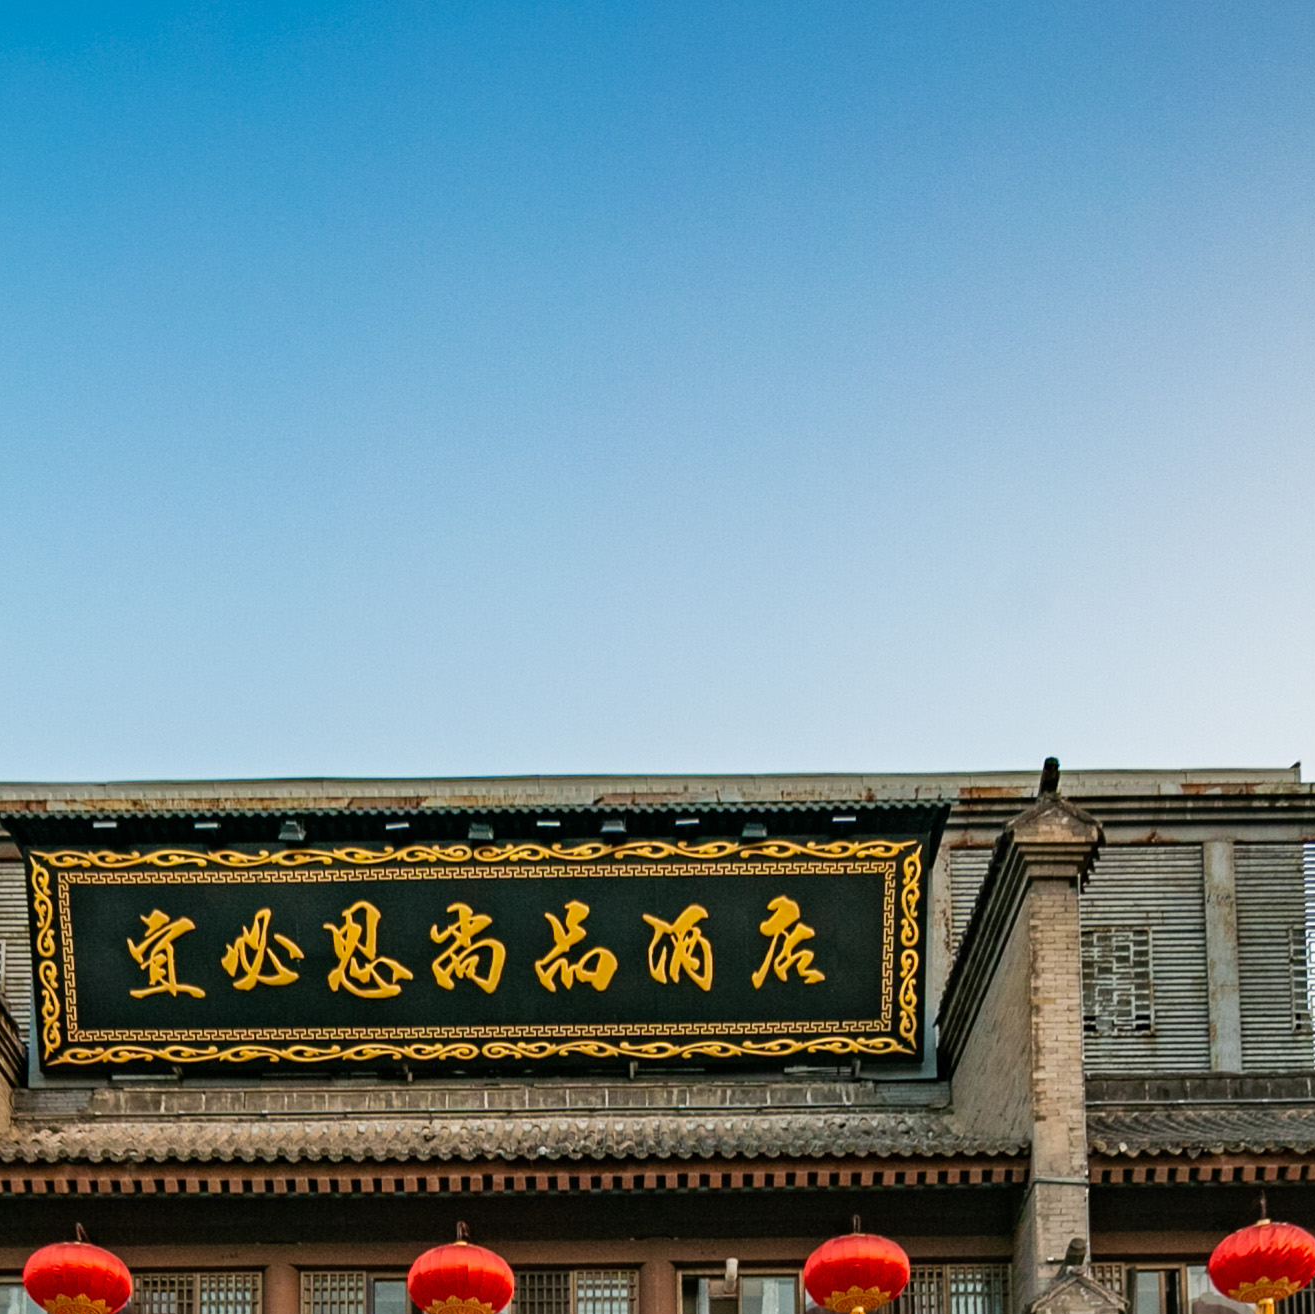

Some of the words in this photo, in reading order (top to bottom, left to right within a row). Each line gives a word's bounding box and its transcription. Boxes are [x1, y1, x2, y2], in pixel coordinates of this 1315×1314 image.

[128, 895, 825, 999] 宜必思尚品酒店
